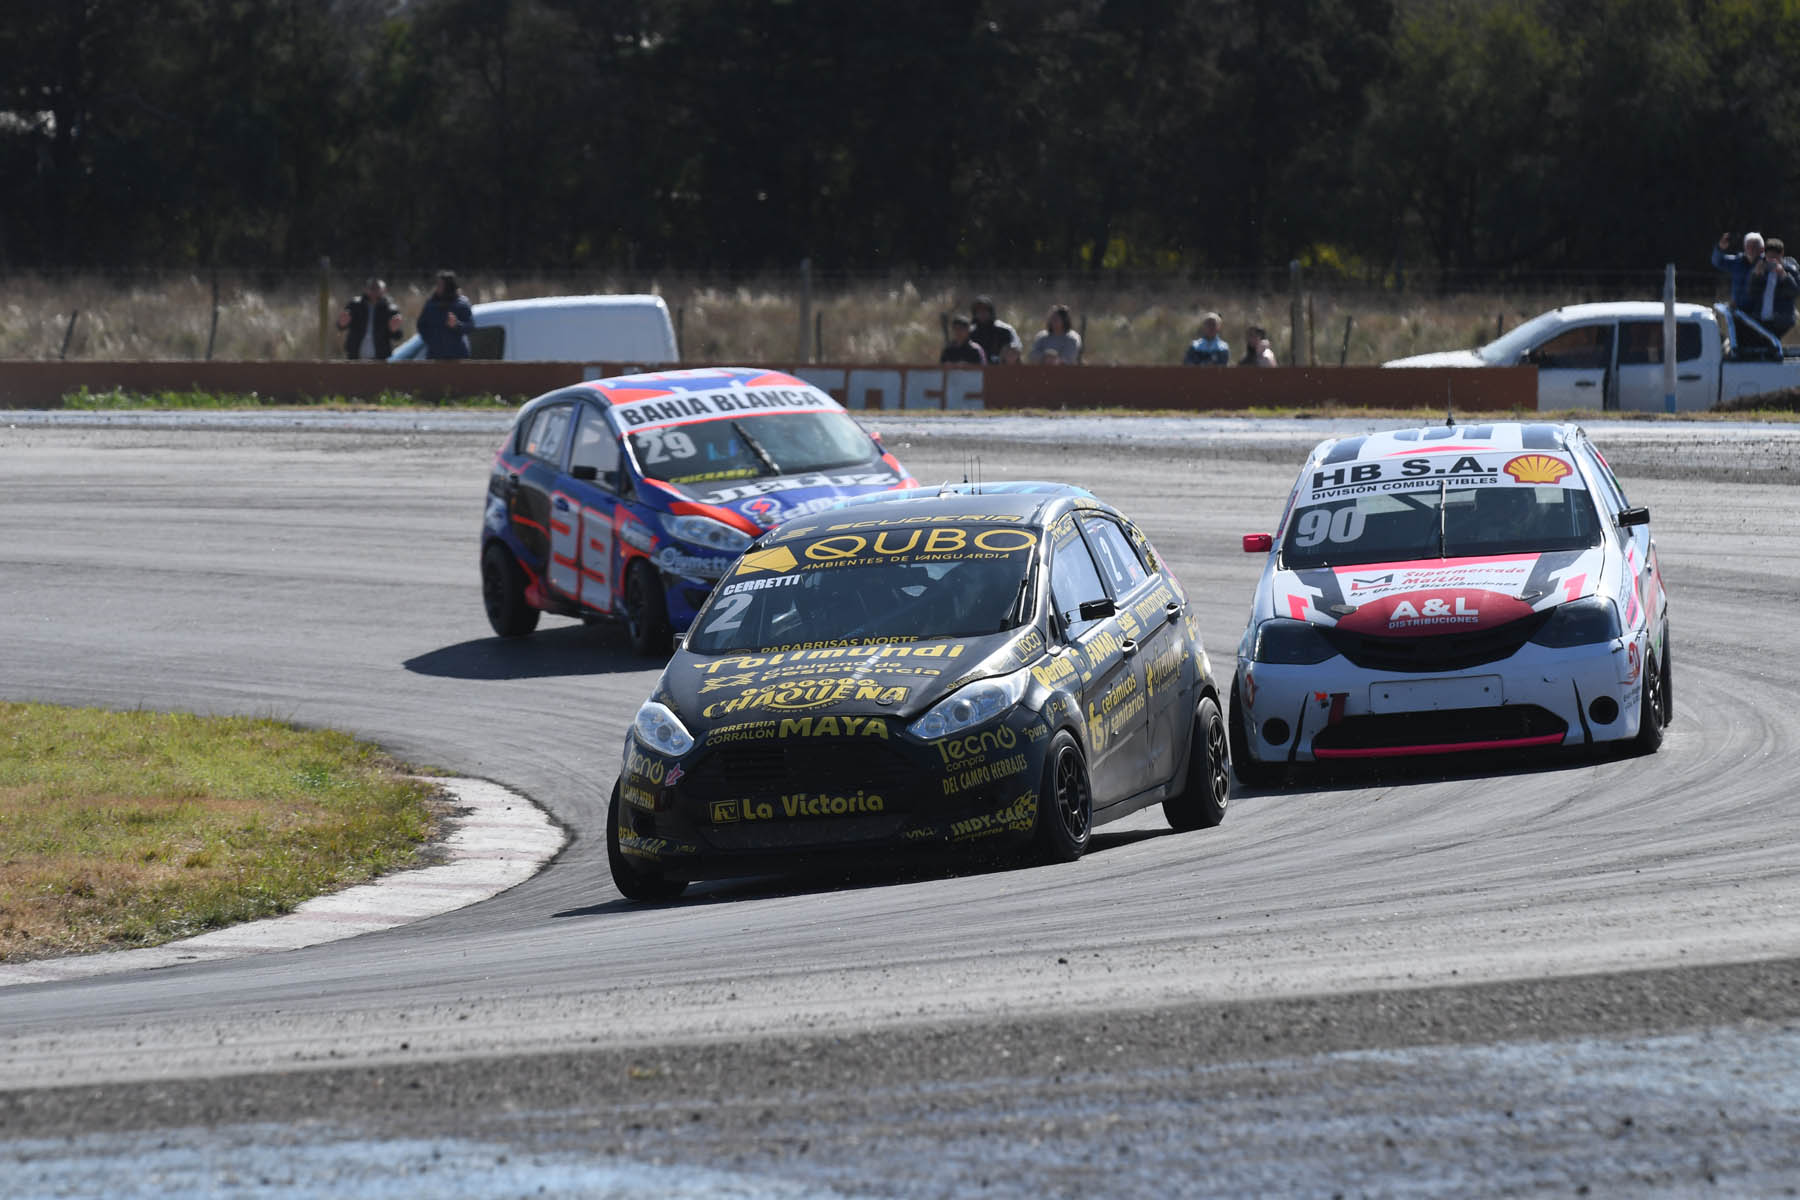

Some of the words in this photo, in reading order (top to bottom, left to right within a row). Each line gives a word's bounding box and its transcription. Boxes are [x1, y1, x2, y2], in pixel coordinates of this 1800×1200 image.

[620, 396, 712, 426] BAHIA
[712, 390, 824, 413] BLANCA
[636, 431, 697, 464] 29
[1312, 462, 1382, 489] HB
[1401, 455, 1498, 477] S.A.
[1311, 483, 1378, 500] DIVISIÓN
[1382, 476, 1498, 493] COMBUSTIBLES
[1296, 507, 1367, 547] 90
[550, 491, 614, 614] 29
[804, 528, 1038, 561] QUBO
[801, 557, 883, 571] AMBIENTES
[890, 555, 910, 563] DE
[914, 552, 1010, 562] VANGUARDIA
[723, 574, 801, 596] CERRETTI
[704, 594, 753, 634] 2
[1388, 616, 1479, 629] DISTRIBUCIONES
[1389, 596, 1479, 619] A&L
[761, 638, 861, 653] PARABRISAS
[864, 636, 919, 646] NORTE
[708, 720, 777, 737] FERRETERIA
[778, 716, 889, 740] MAYA
[943, 777, 959, 795] DEL
[960, 769, 990, 791] CAMPO
[991, 753, 1028, 778] HERRAJES
[743, 799, 773, 820] La
[781, 790, 884, 816] Victoria
